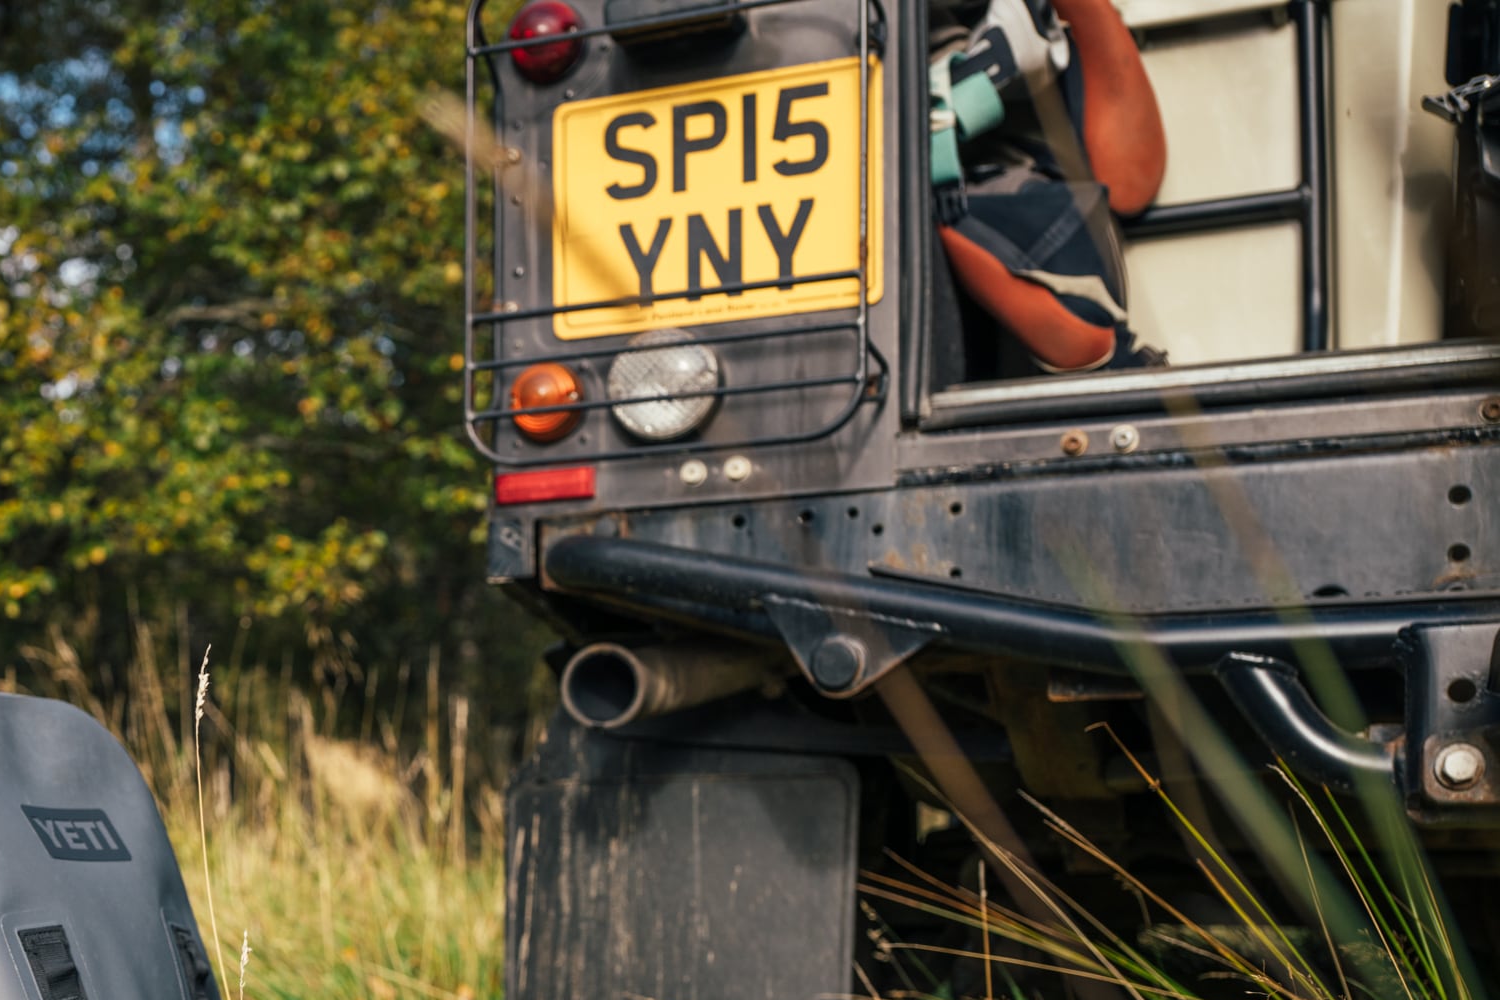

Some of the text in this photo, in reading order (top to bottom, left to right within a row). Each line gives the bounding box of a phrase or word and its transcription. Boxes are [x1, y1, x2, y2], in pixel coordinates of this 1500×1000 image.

[604, 81, 830, 201] SP15
[618, 197, 815, 307] YNY
[31, 817, 120, 850] YETI
